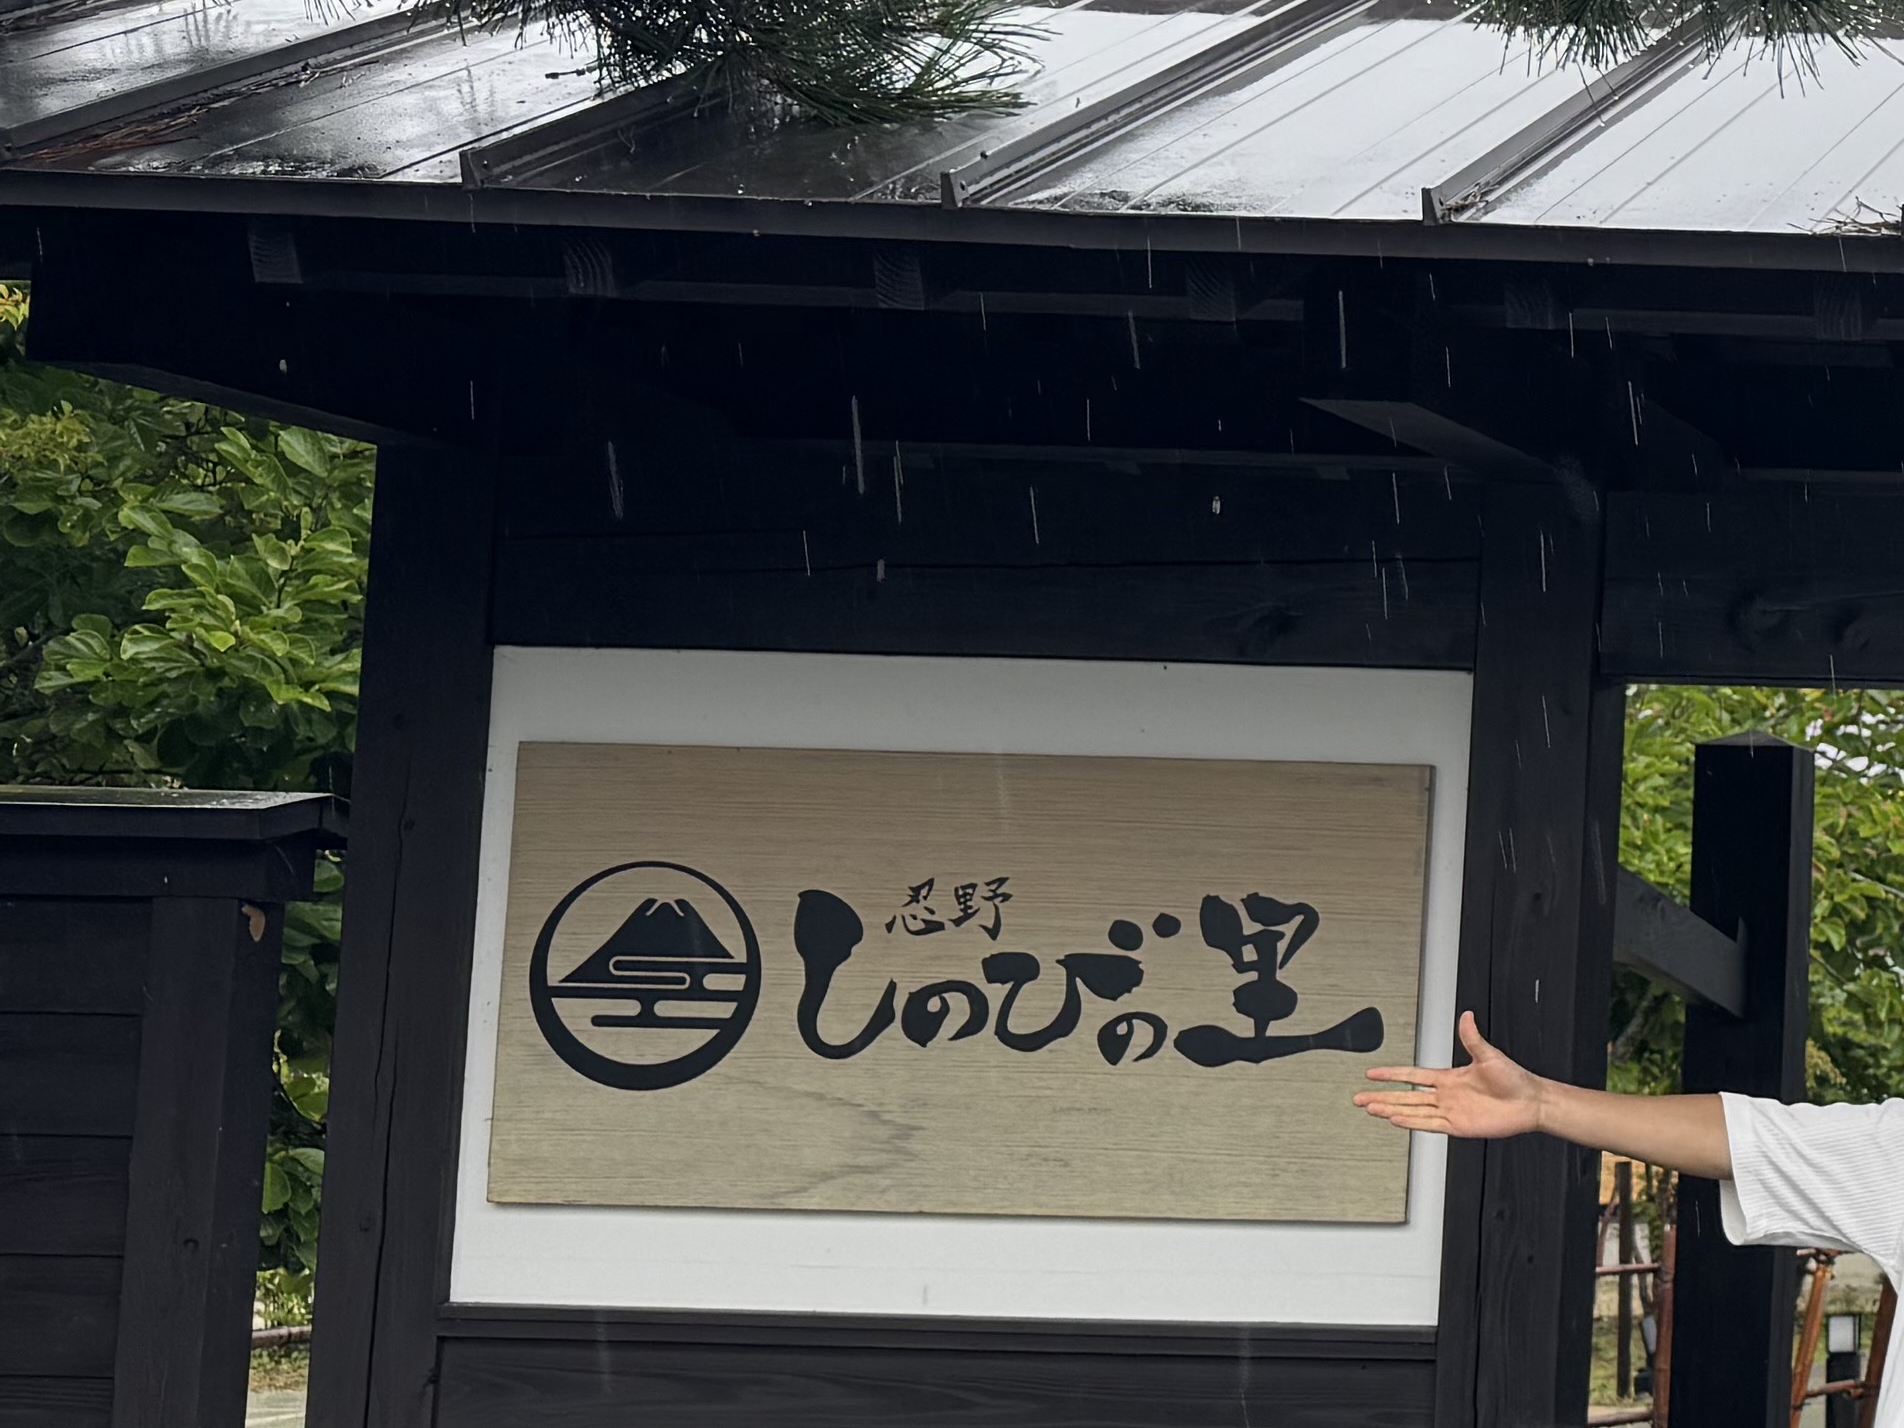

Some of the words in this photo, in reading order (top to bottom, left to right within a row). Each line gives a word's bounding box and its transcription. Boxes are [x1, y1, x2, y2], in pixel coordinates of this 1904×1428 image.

[885, 876, 1014, 942] 忍野
[793, 889, 1384, 1068] しのびの里
